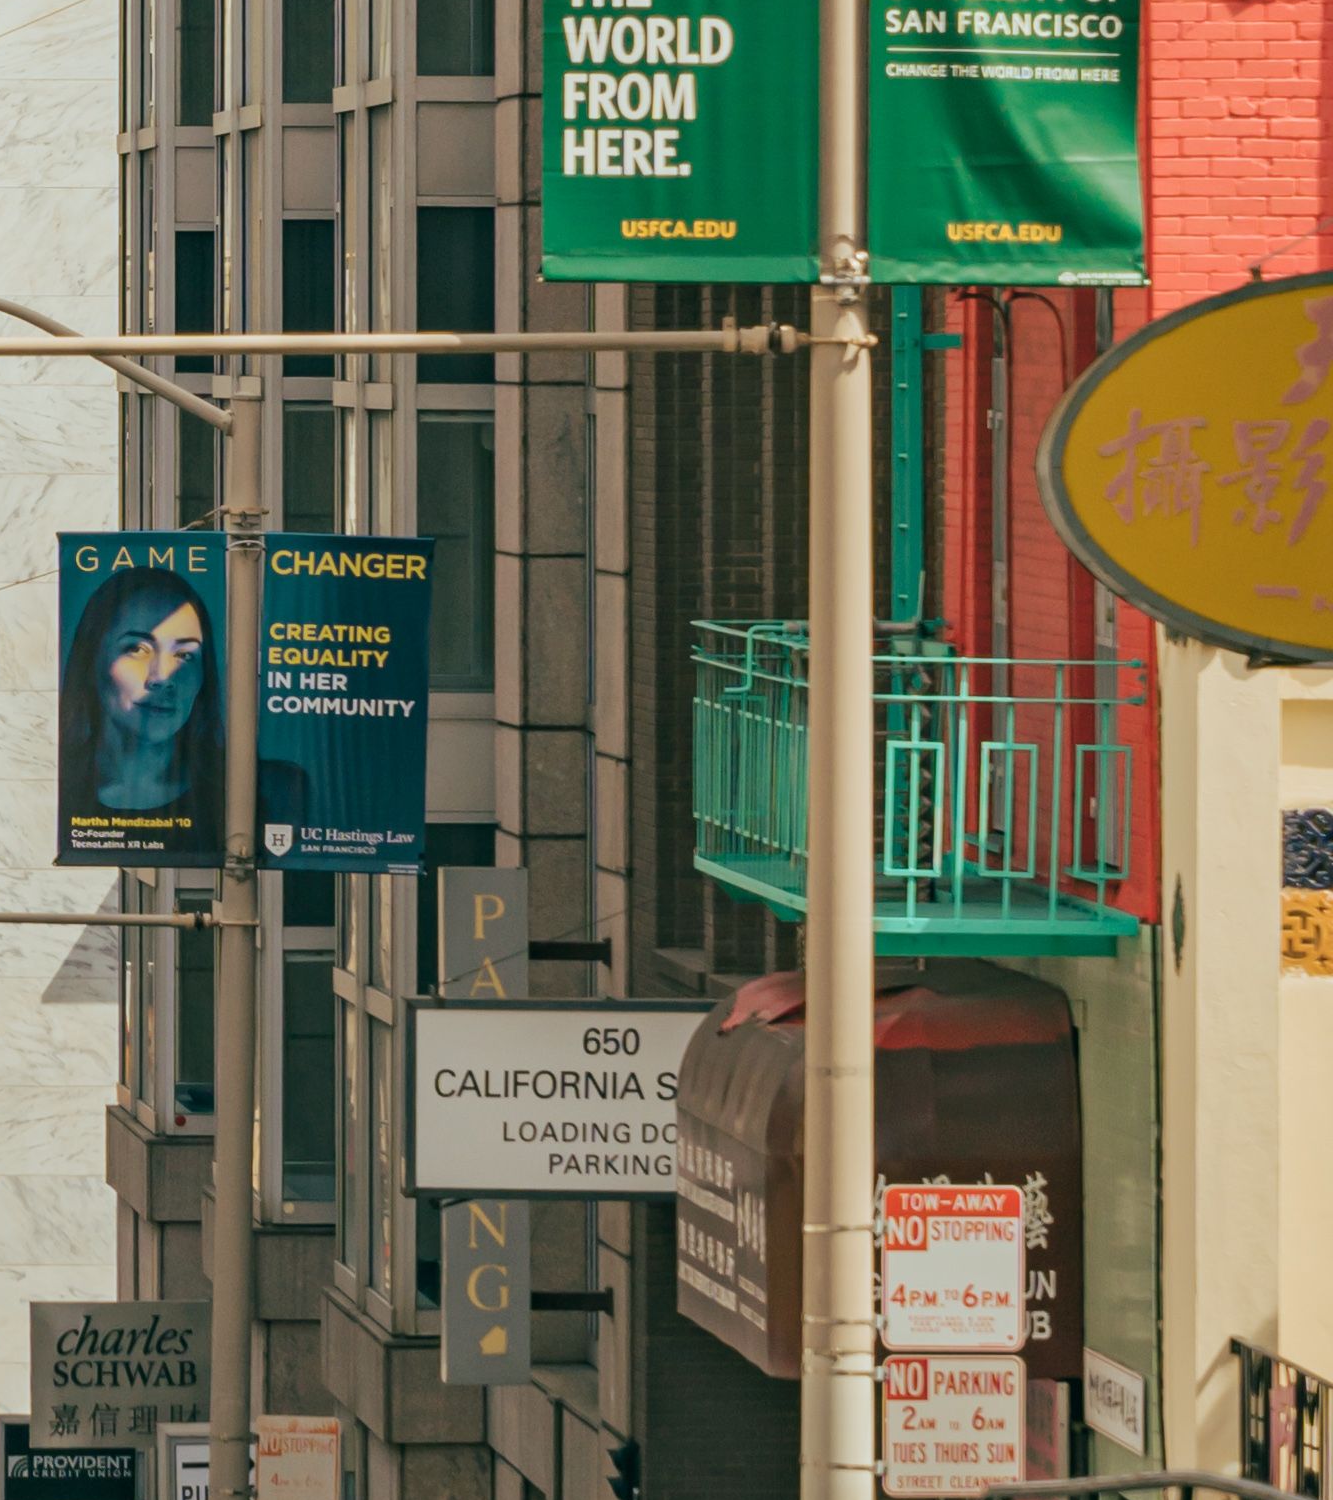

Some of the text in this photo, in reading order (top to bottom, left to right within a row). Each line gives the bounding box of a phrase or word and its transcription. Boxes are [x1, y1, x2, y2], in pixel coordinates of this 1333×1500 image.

[886, 9, 1123, 39] SAN FRANCISCO
[562, 15, 733, 65] WORLD
[885, 64, 1120, 82] CHANGE THE WORLD FROM HERE
[563, 71, 697, 120] FROM
[563, 128, 691, 177] HERE.
[621, 219, 737, 238] USFCA.EDU
[946, 222, 1062, 242] USFCA.EDU
[75, 546, 208, 572] GAME
[271, 550, 426, 580] CHANGER
[269, 623, 391, 644] CREATING
[268, 647, 389, 668] EQUALITY
[267, 671, 348, 691] IN HER
[267, 695, 415, 718] COMMUNITY
[71, 816, 109, 827] Martha
[71, 829, 125, 839] Co-Founder
[300, 827, 415, 845] UC Hastings Law
[300, 844, 320, 853] SAN
[582, 1028, 640, 1055] 650
[434, 1069, 645, 1100] CALIFORNIA
[502, 1121, 631, 1144] LOADING
[548, 1153, 672, 1176] PARKING
[899, 1192, 1007, 1212] TOW-AWAY
[887, 1215, 1015, 1247] NO STOPPING
[56, 1314, 193, 1357] charles
[53, 1359, 198, 1389] SCHWAB
[887, 1361, 1015, 1397] NO PARKING
[902, 1405, 1005, 1431] 2AM 6AM
[260, 1434, 334, 1455] NO STOPPING
[892, 1442, 1016, 1464] TUES THURS SUN
[33, 1455, 132, 1469] PROVIDENT
[33, 1469, 132, 1478] CREDIT UNION
[896, 1475, 944, 1489] STREET
